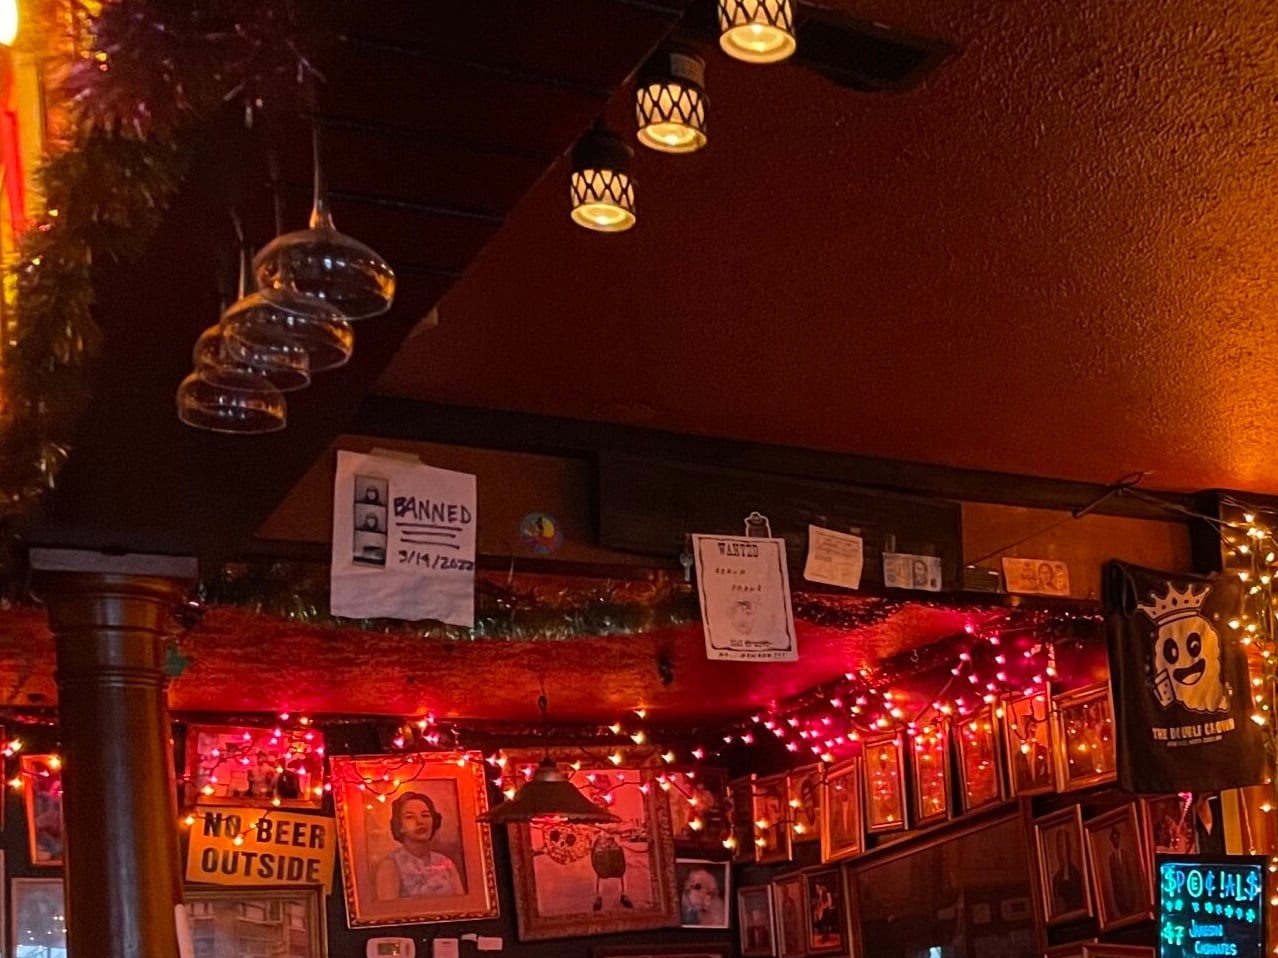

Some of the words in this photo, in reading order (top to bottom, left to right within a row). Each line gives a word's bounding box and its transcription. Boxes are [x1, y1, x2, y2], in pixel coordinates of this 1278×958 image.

[394, 496, 472, 524] BANNED
[717, 542, 759, 558] WANTED
[1152, 727, 1168, 740] THE
[204, 812, 241, 840] NO
[256, 817, 326, 849] BEER
[201, 847, 321, 883] OUTSIDE
[1161, 921, 1184, 946] $7
